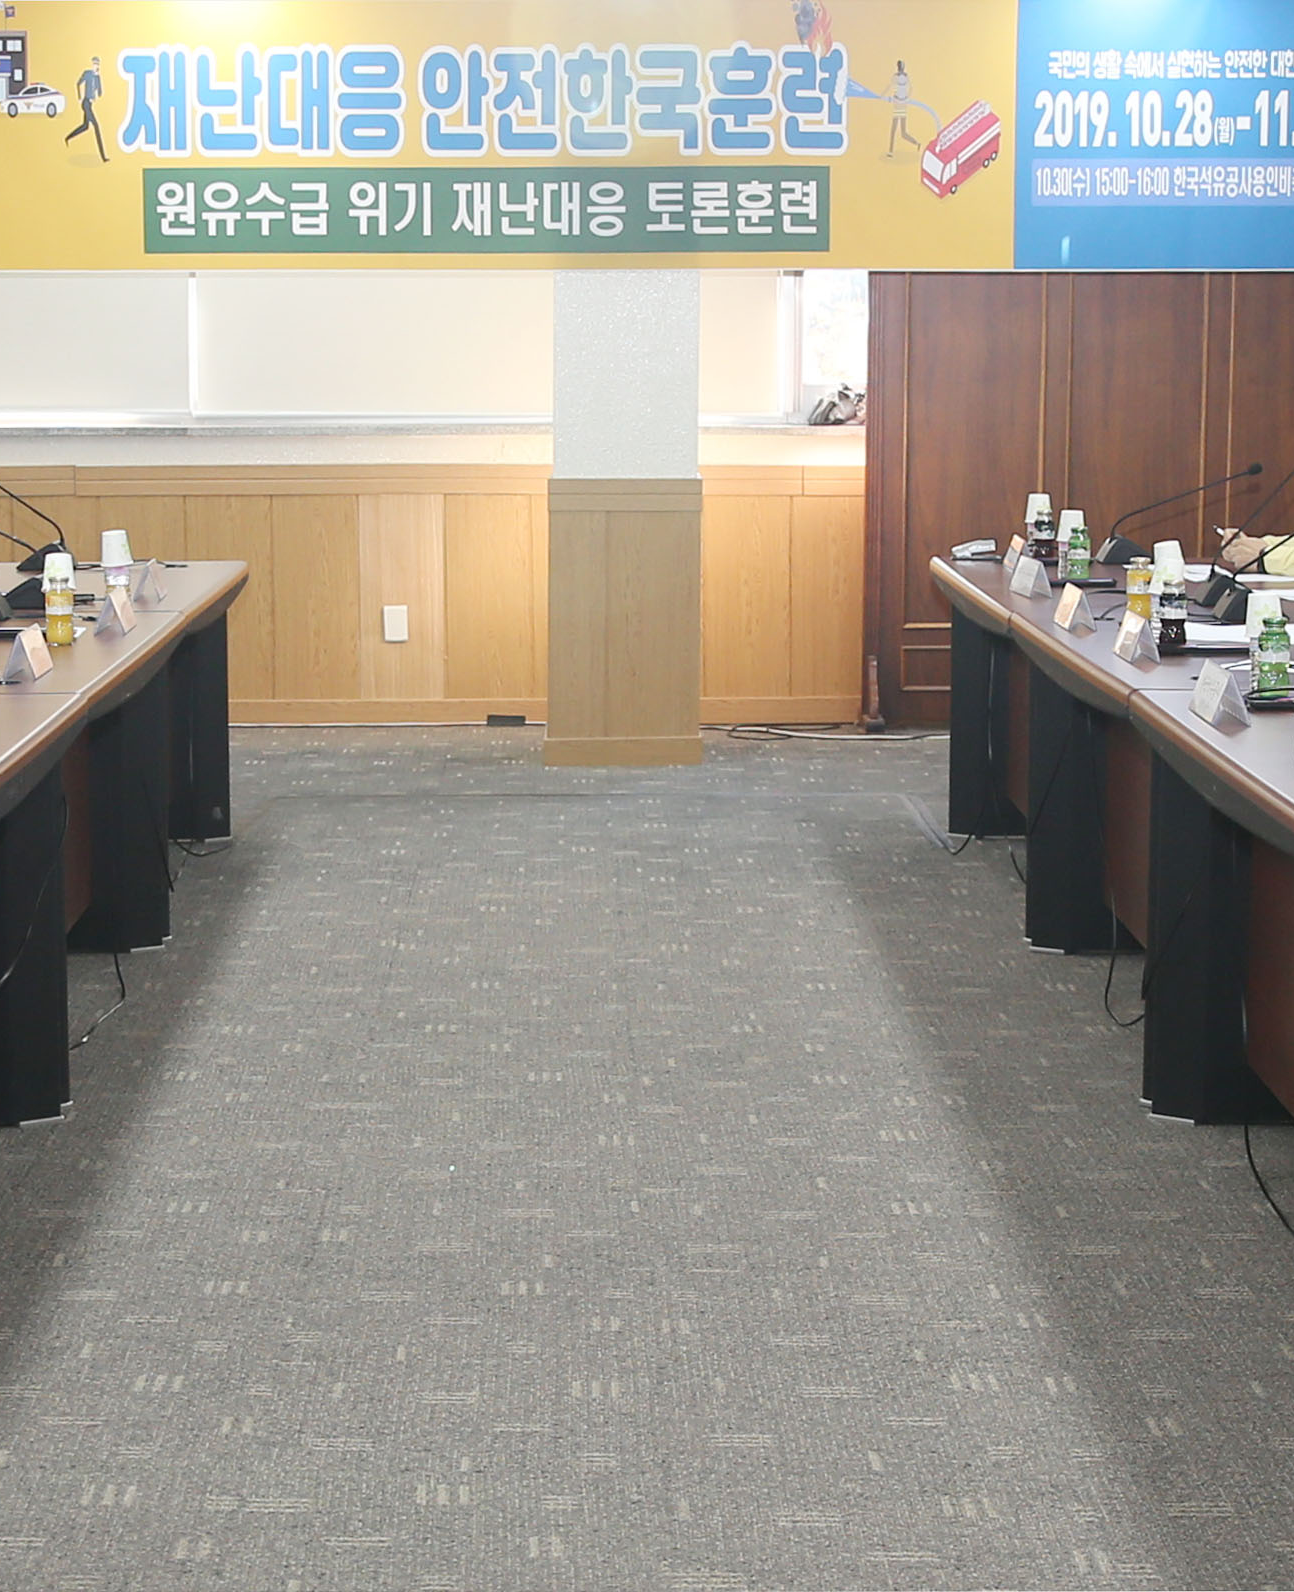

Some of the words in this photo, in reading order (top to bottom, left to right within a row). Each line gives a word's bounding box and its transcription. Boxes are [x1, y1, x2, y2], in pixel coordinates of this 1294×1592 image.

[1047, 50, 1091, 80] 국민의
[1092, 49, 1123, 80] 생활
[1123, 49, 1165, 79] 속에서
[1166, 49, 1223, 79] 실현하는
[1224, 49, 1268, 78] 안전한
[119, 44, 405, 157] 재난대응
[420, 41, 848, 157] 안전한국훈련
[1035, 166, 1091, 198] 10.30(수)
[1094, 166, 1170, 197] 15:00-16:00
[155, 181, 331, 236] 원유수급
[347, 180, 433, 236] 위기
[451, 180, 627, 237] 재난대응
[645, 180, 818, 235] 토론훈련
